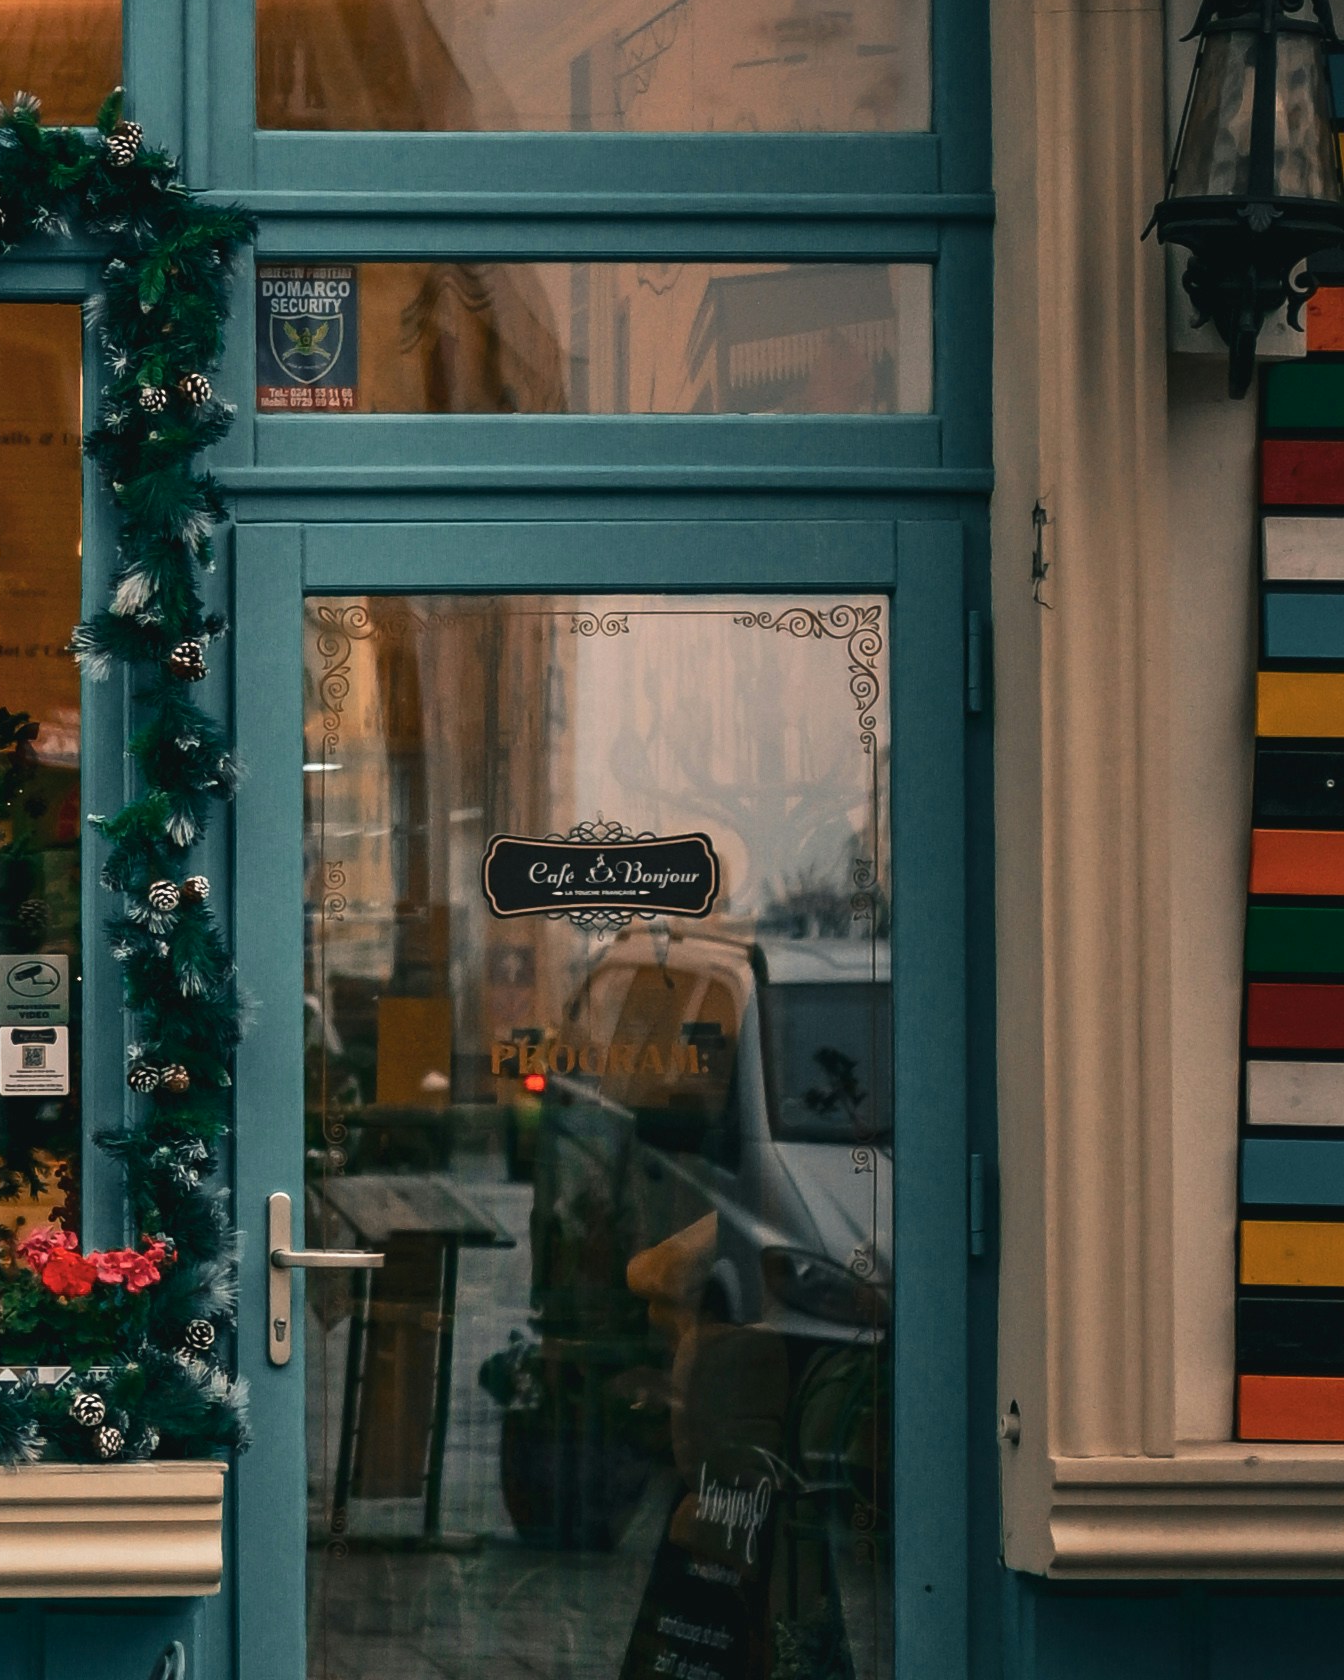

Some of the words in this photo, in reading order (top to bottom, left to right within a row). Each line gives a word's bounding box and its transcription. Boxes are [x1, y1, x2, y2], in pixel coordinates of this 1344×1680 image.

[262, 280, 351, 298] DOMARCO
[270, 298, 342, 313] SECURITY
[528, 861, 575, 890] Café
[615, 861, 700, 889] Bonjour
[18, 1011, 50, 1019] VIDEO
[490, 1043, 710, 1075] PROGRAM:
